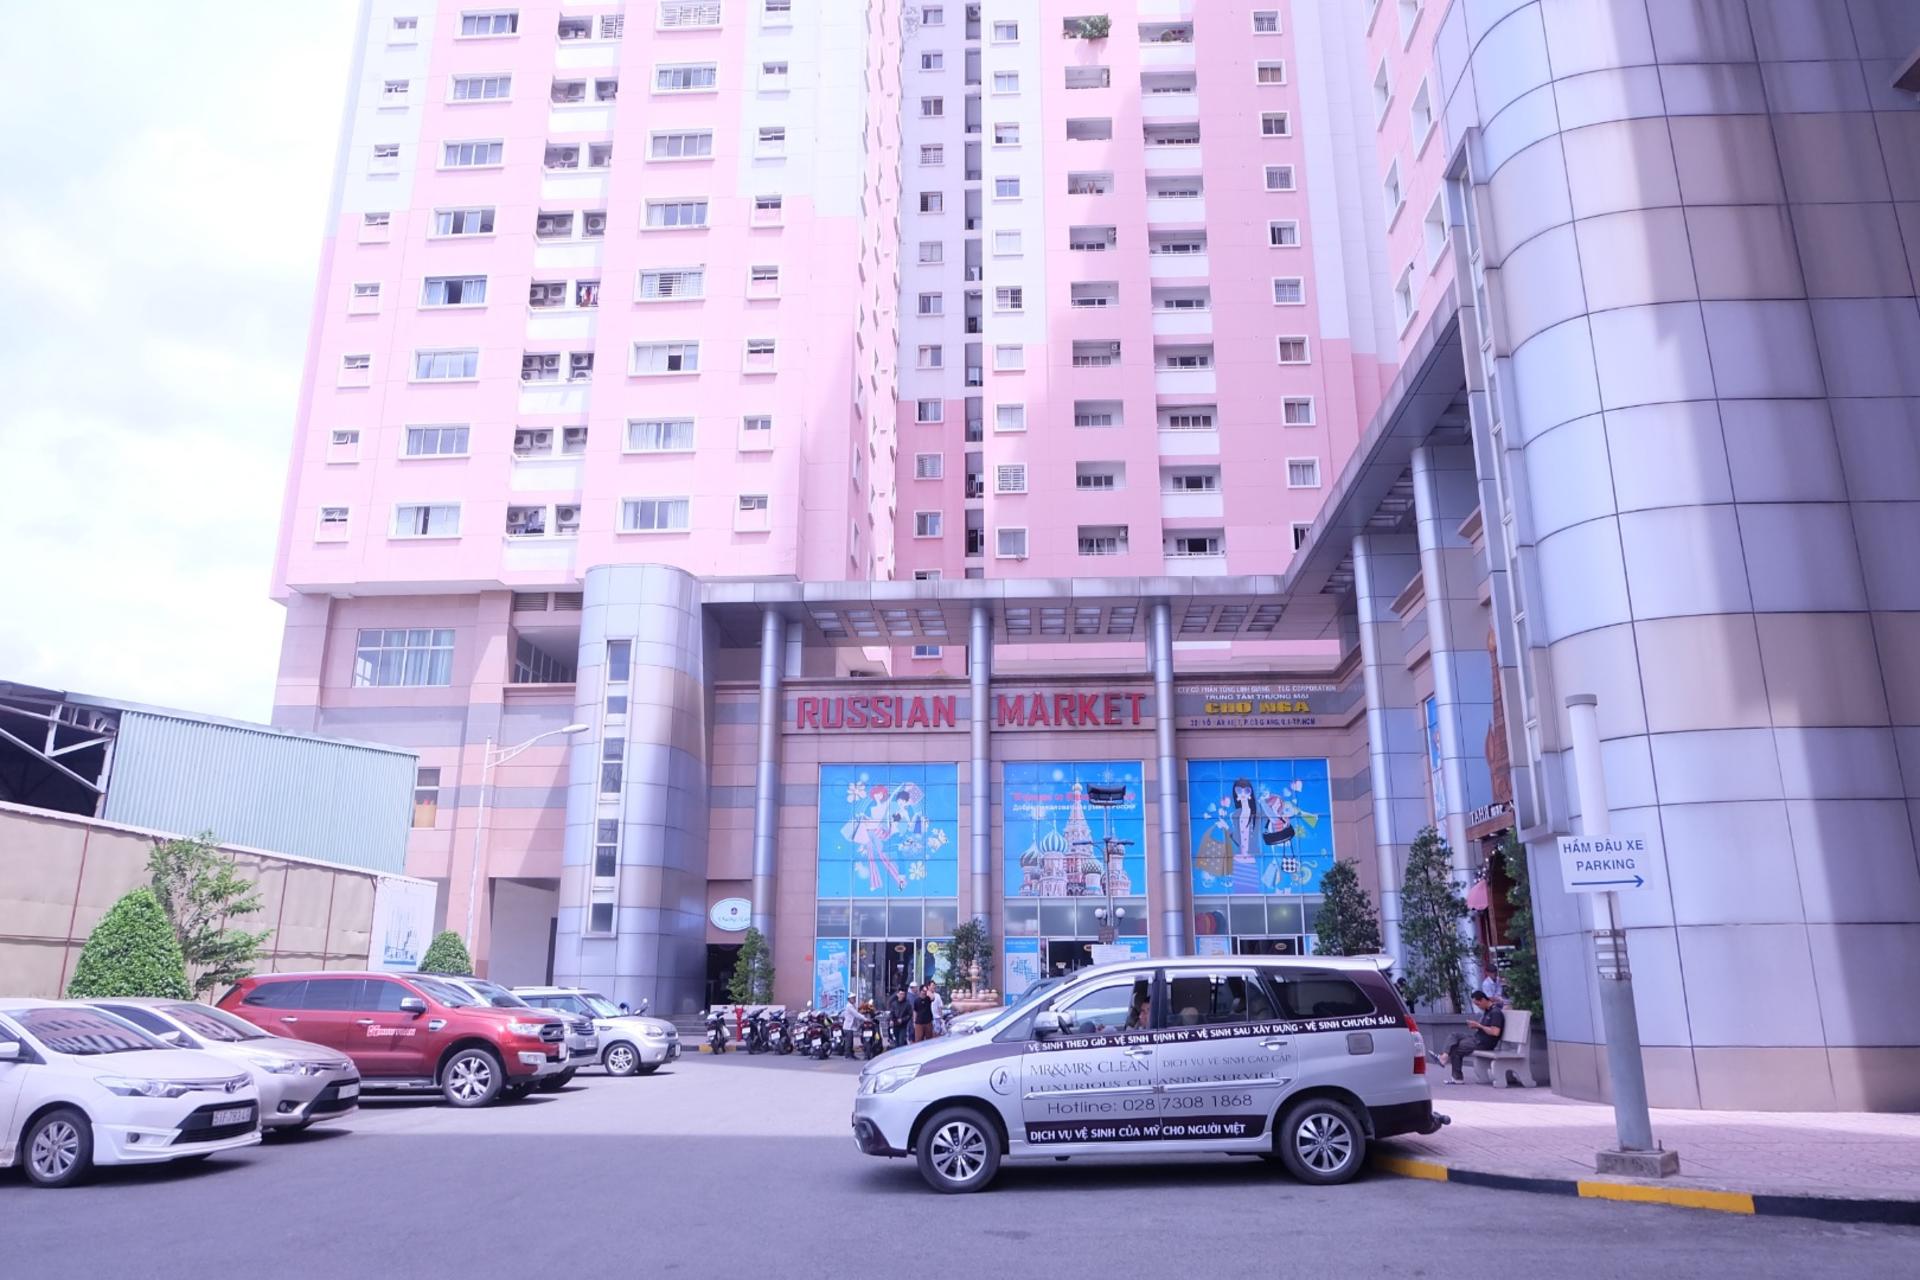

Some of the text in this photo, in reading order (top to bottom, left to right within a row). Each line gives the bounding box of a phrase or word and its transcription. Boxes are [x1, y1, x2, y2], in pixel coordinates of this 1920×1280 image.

[797, 692, 1146, 729] RUSSIAN MARKET
[1595, 838, 1622, 854] ĐẬU
[1626, 840, 1644, 851] XE
[1576, 858, 1635, 871] PARKING
[1042, 1041, 1063, 1051] SINH
[1065, 1039, 1089, 1050] THEO
[1128, 1035, 1149, 1045] SINH
[1210, 1028, 1231, 1038] SINH
[1233, 1025, 1250, 1036] SAU
[1319, 1021, 1340, 1030] SINH
[1342, 1016, 1377, 1027] CHUYÊN
[1223, 1056, 1245, 1065] SINH
[1248, 1054, 1269, 1063] CAO
[1030, 1060, 1150, 1077] MR&MRS CLEAN
[1030, 1079, 1121, 1092] LUXURIOUS
[1048, 1094, 1253, 1114] Hotline: 028 7308 1868
[1030, 1122, 1246, 1142] DỊCH VỤ VỆ SINH CỦA MỸ CHO NGƯỜI VIỆT
